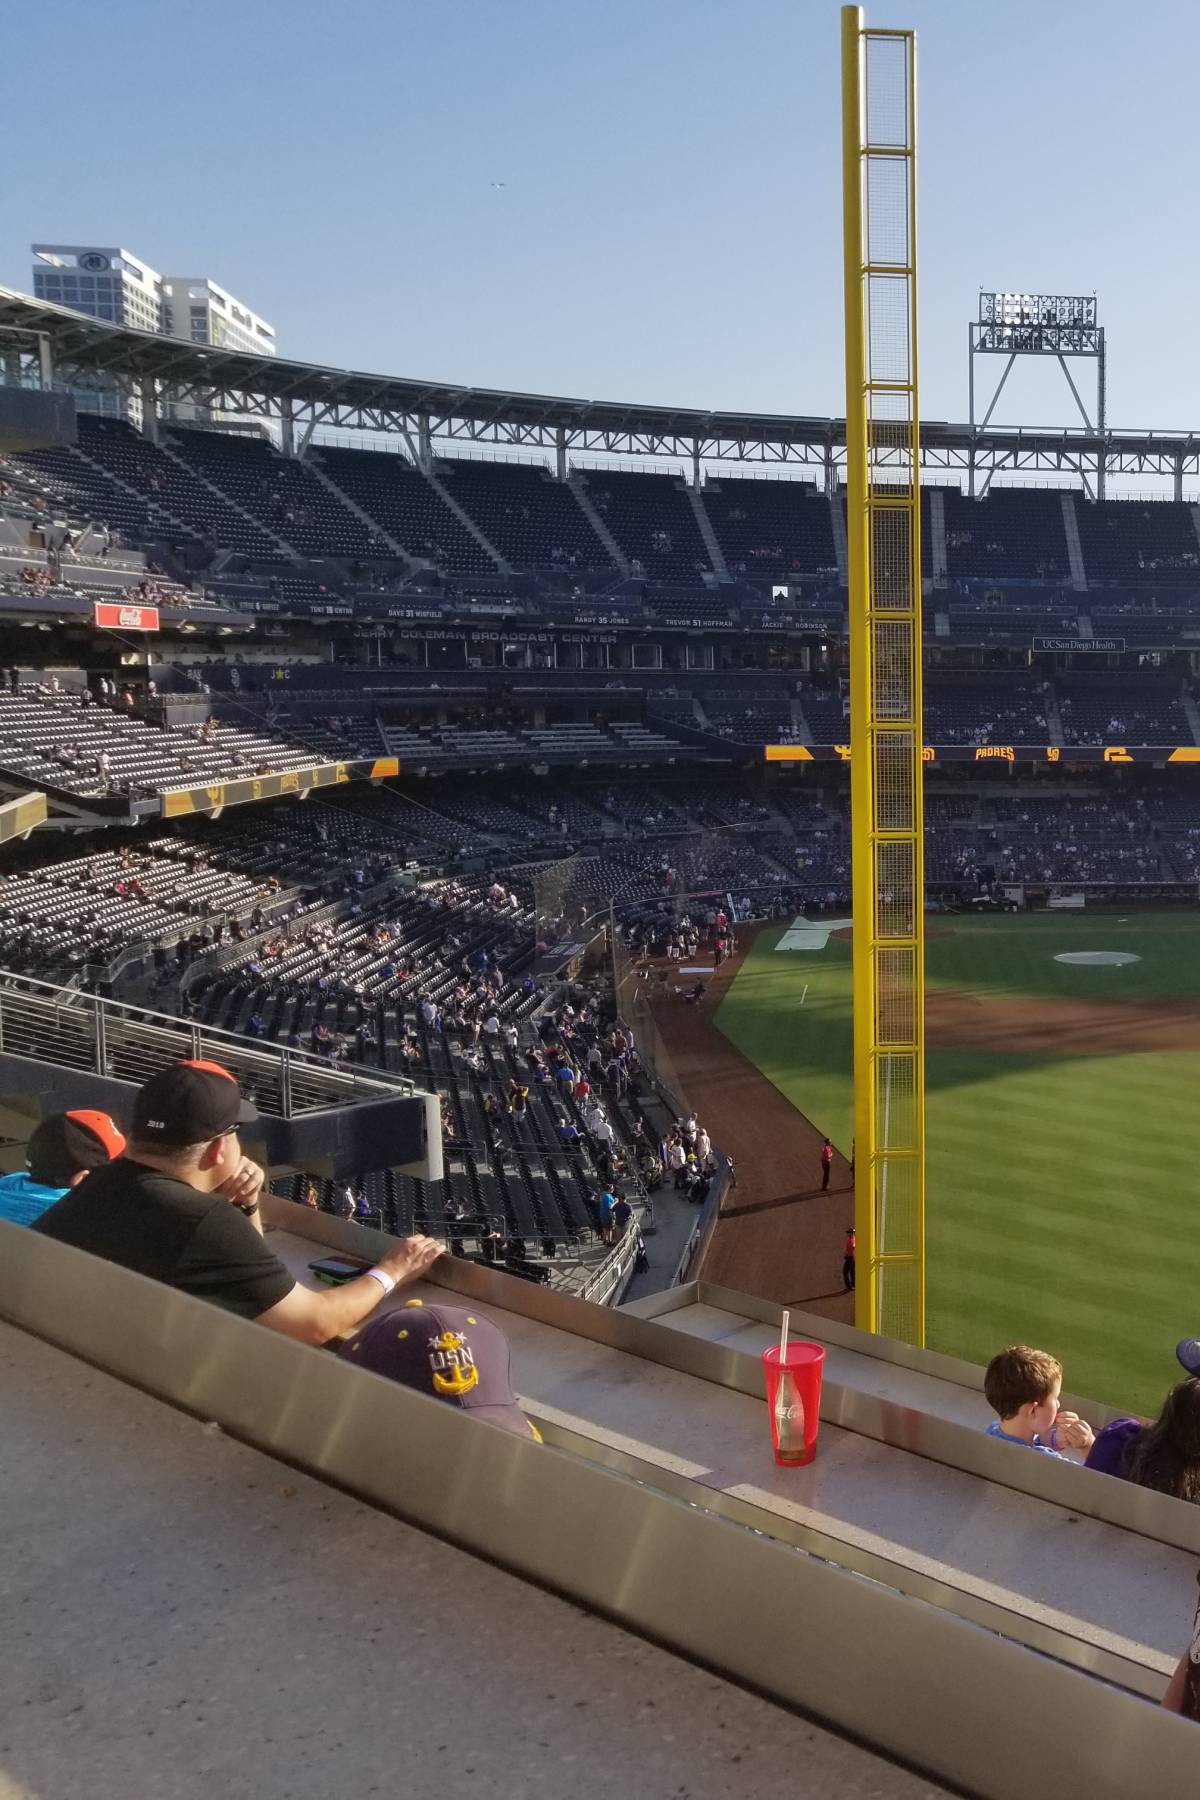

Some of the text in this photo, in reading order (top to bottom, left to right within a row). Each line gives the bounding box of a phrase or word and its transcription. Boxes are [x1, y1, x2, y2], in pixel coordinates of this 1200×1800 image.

[388, 609, 404, 617] DAVE
[405, 609, 414, 618] 31
[574, 616, 629, 625] RANDY 35 JONES
[665, 619, 733, 628] TREVOR 51 HOFFMAN
[795, 622, 828, 630] ROBINSON
[353, 629, 617, 644] JERRY COLEMAN BROADCAST CENTER
[1055, 640, 1069, 649] San
[1070, 640, 1091, 651] Diego
[1092, 640, 1116, 650] Health
[975, 746, 1015, 761] PADRES
[430, 1347, 474, 1369] USN
